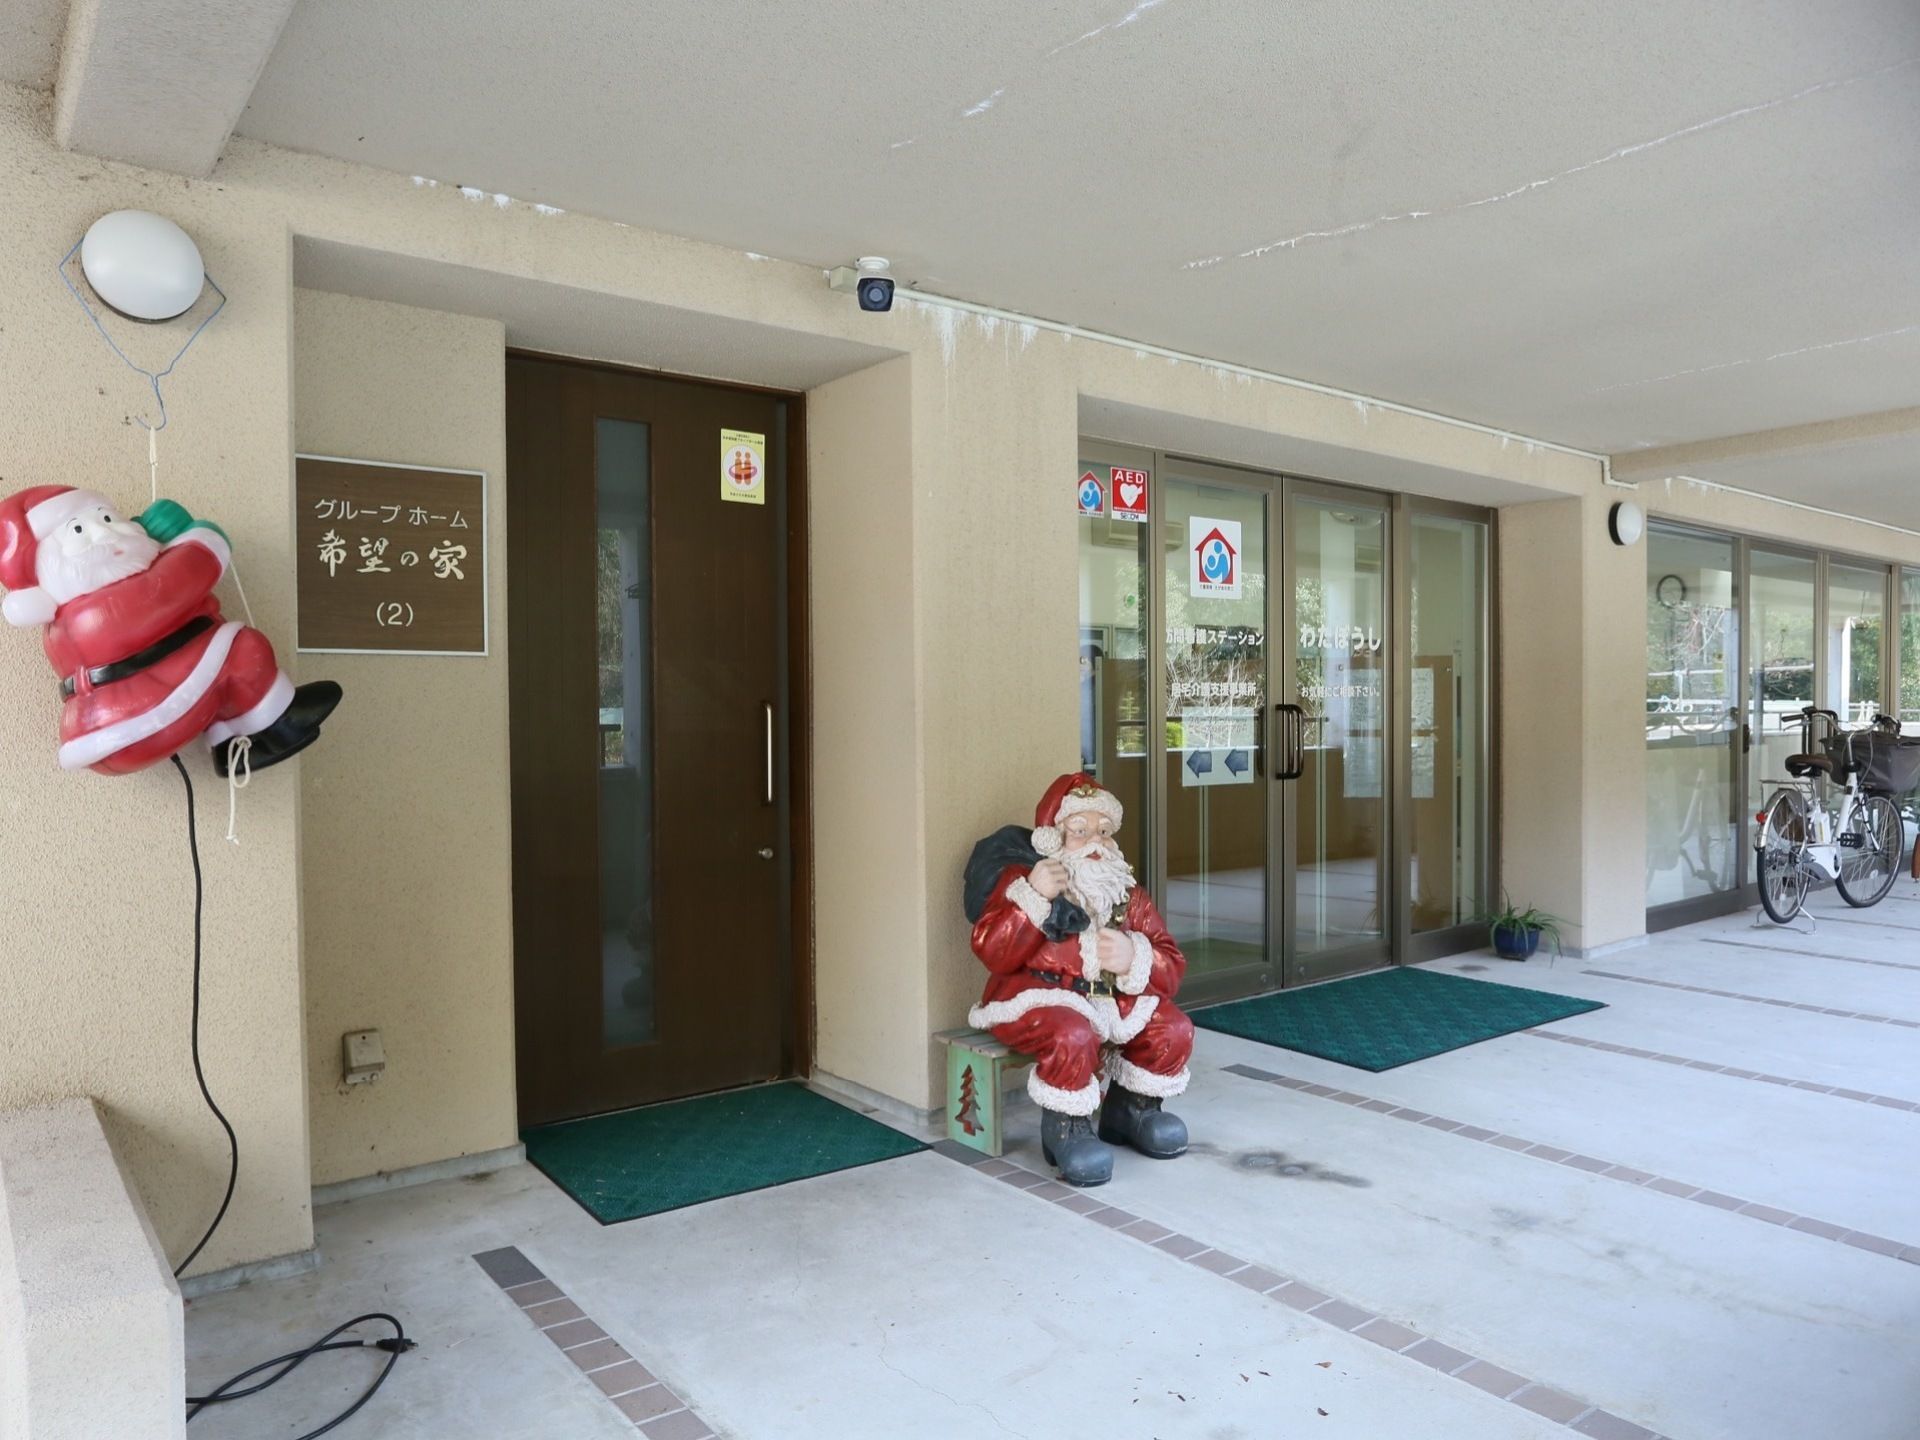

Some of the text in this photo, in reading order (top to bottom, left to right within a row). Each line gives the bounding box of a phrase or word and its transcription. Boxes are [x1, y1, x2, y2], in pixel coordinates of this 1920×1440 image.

[1114, 470, 1144, 484] AED
[317, 528, 467, 580] 希望の家
[376, 602, 414, 626] (2)
